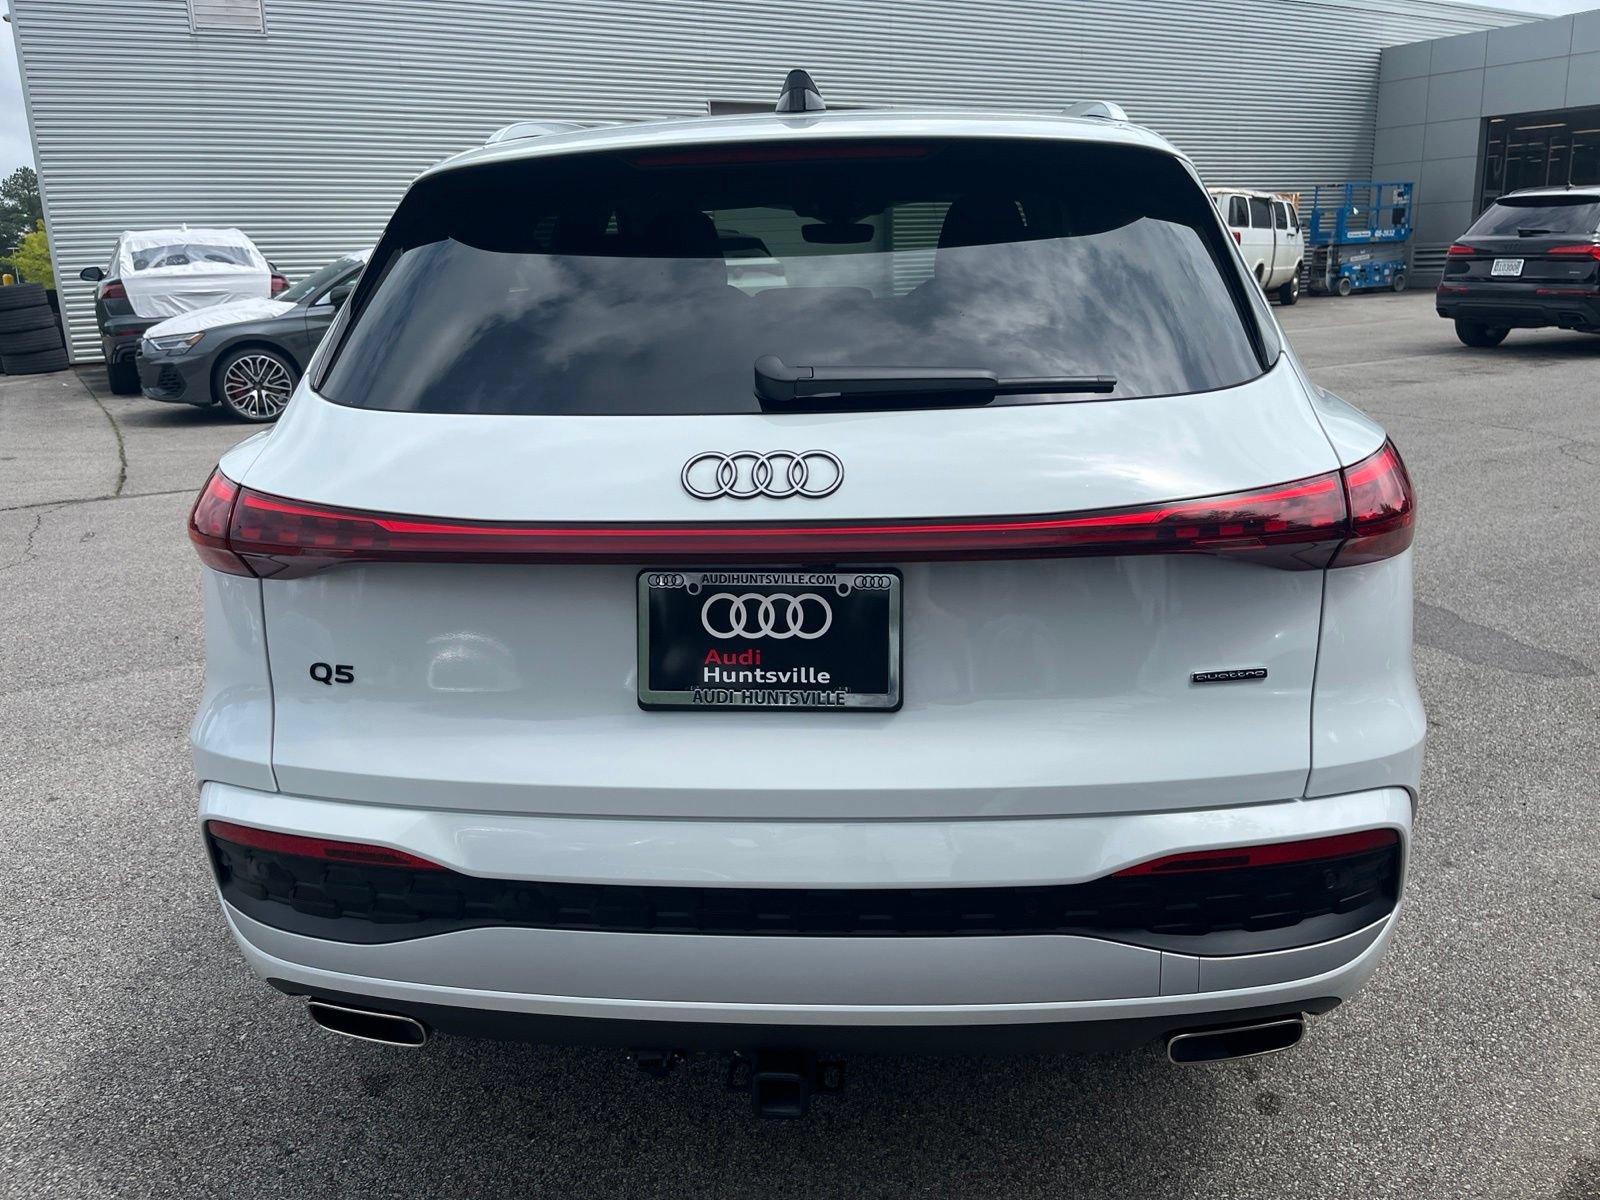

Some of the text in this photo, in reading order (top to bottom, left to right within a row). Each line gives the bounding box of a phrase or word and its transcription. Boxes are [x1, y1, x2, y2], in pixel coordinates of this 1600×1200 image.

[702, 573, 837, 586] AUDIHUNTSVILLE.COM
[704, 649, 761, 665] Audi
[309, 662, 355, 686] Q5
[703, 667, 831, 684] Huntsville
[1195, 669, 1266, 681] quattro
[692, 686, 847, 707] AUDI HUNTSVILLE
